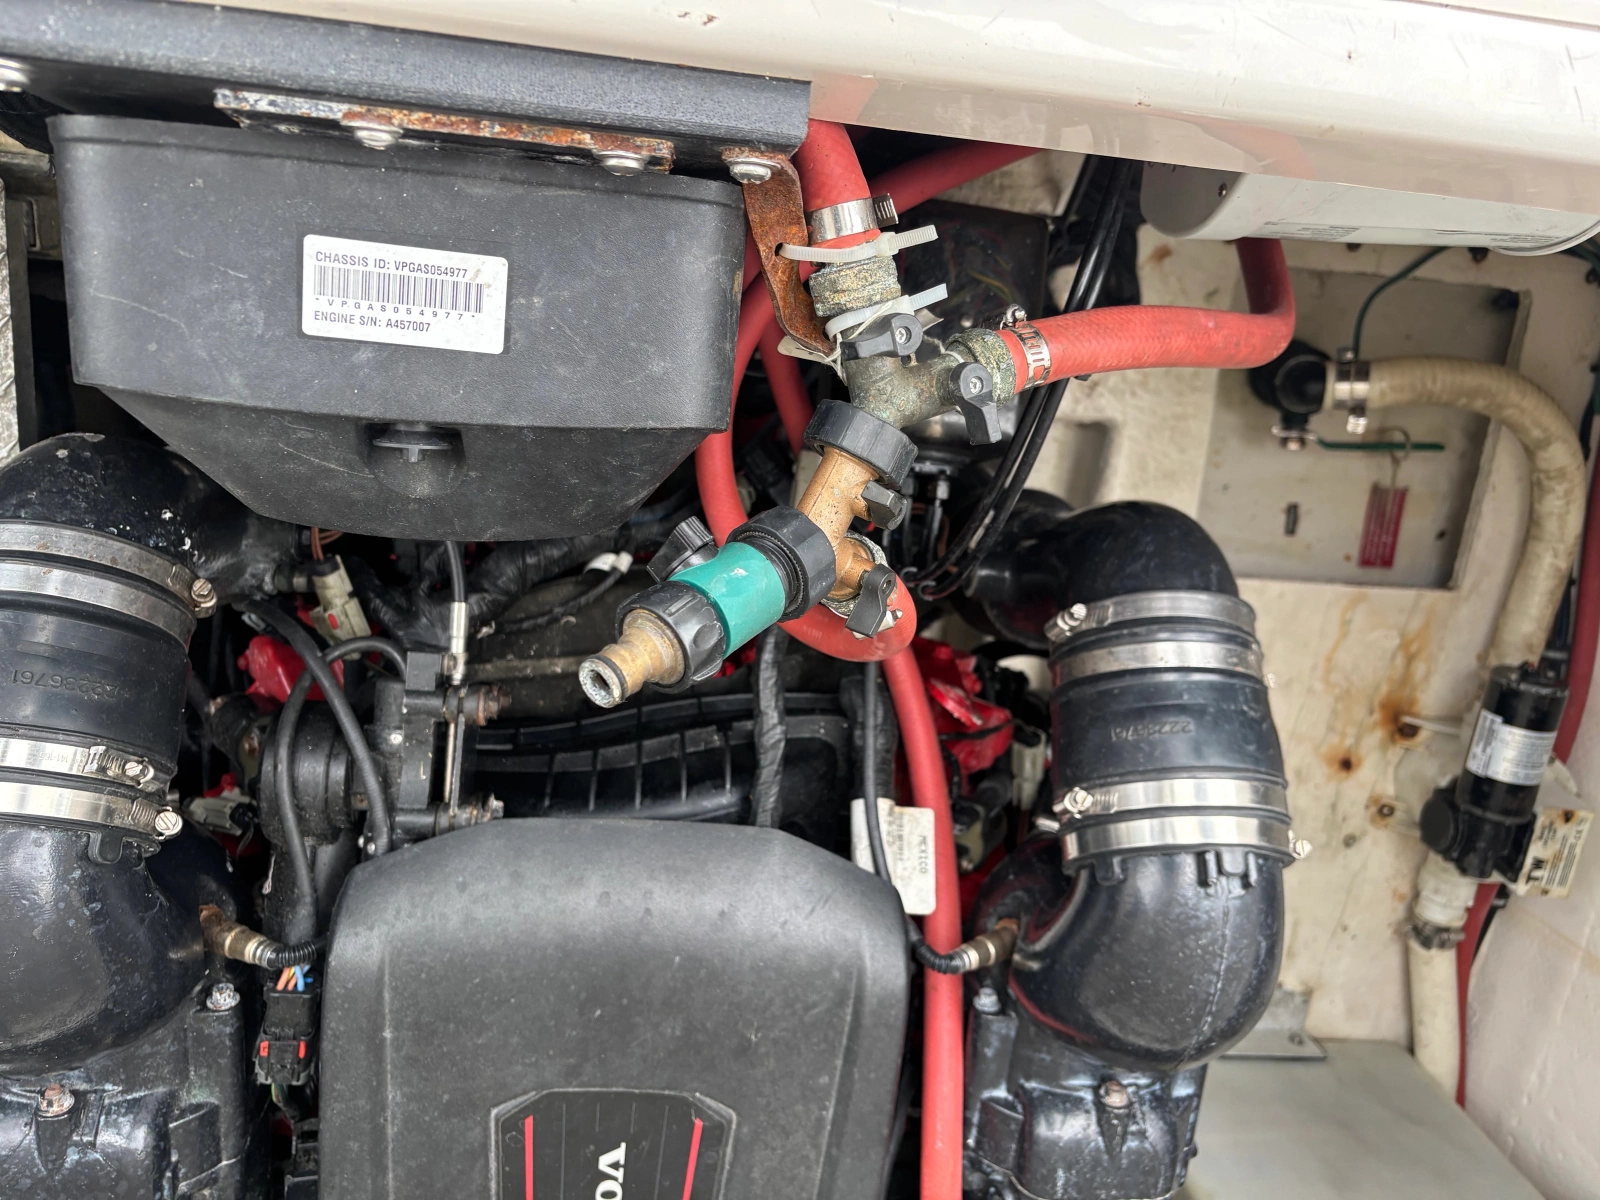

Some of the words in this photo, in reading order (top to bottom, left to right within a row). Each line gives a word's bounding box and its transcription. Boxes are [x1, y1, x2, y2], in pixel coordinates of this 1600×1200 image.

[315, 251, 369, 267] CHASSIS
[374, 258, 390, 270] ID:
[394, 260, 468, 279] VPGAS054977
[314, 310, 356, 325] ENGINE
[359, 315, 382, 327] S/N:
[385, 319, 431, 332] A457007
[918, 835, 929, 874] MEXICO
